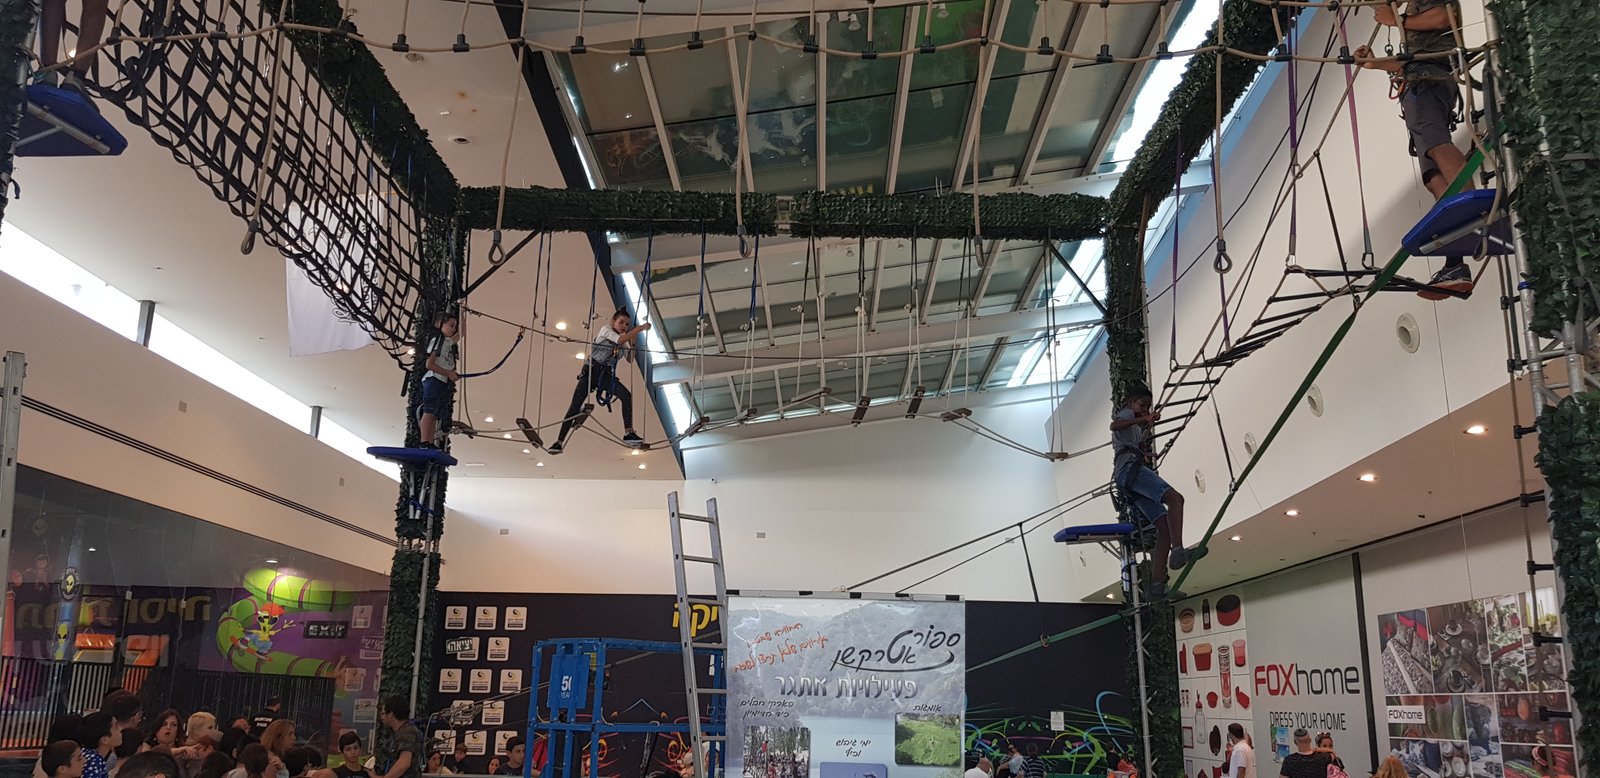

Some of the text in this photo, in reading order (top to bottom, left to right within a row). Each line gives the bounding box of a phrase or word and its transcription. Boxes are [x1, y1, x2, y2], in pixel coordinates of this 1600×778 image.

[450, 640, 473, 652] יציאה
[775, 675, 919, 701] פעילויות אתגר
[1254, 663, 1361, 697] FOXhome
[739, 697, 795, 710] פארקי חבלים
[1269, 711, 1347, 731] DRESS YOUR HOME
[1388, 709, 1423, 721] FOXhome
